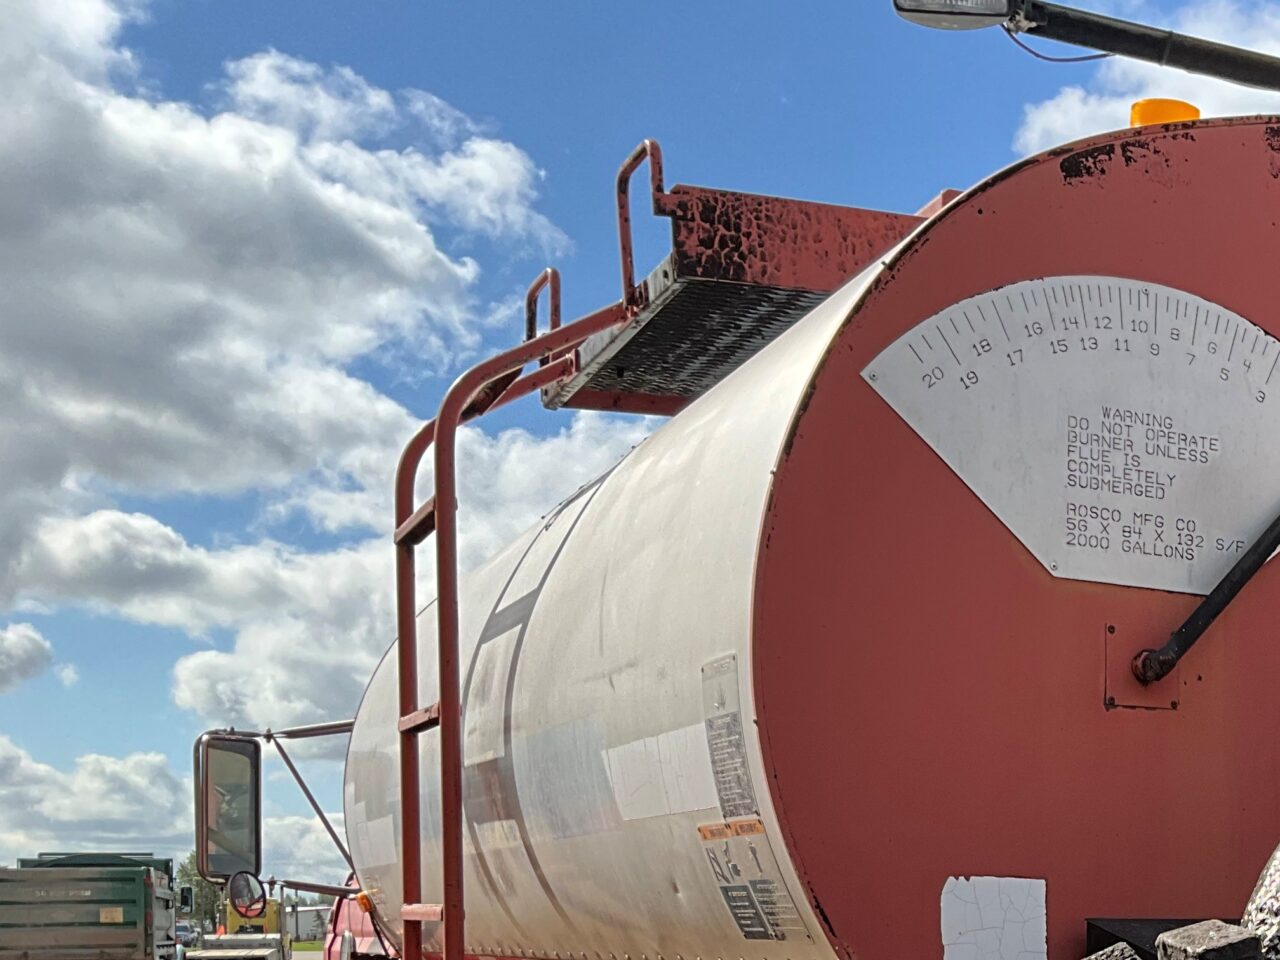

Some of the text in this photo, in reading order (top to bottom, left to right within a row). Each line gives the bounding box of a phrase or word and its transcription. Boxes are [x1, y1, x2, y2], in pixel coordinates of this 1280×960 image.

[921, 365, 945, 389] 20
[971, 338, 993, 358] 18
[1024, 320, 1044, 339] 16
[1060, 315, 1080, 331] 14
[1094, 315, 1113, 330] 12
[1130, 318, 1149, 334] 10
[1170, 327, 1181, 341] 8
[1207, 340, 1218, 355] 6
[1242, 358, 1253, 373] 4
[959, 369, 979, 391] 19
[1005, 347, 1025, 367] 17
[1049, 338, 1070, 355] 15
[1079, 336, 1099, 351] 13
[1114, 337, 1131, 352] 11
[1150, 343, 1161, 357] 9
[1186, 352, 1198, 367] 7
[1219, 366, 1231, 382] 5
[1255, 390, 1267, 404] 3
[1102, 405, 1174, 430] WARNING
[1066, 429, 1210, 464] BURNER UNLESS
[1067, 415, 1220, 452] DO NOT OPERATE
[1066, 444, 1141, 468] FLUE IS
[1066, 458, 1177, 488] COMPLETELY
[1066, 473, 1166, 500] SUBMERGED
[1066, 502, 1197, 533] ROSCO MFG CO
[1066, 517, 1246, 554] 56 X 84 X 132 S/F
[1066, 531, 1196, 562] 2000 GALLONS
